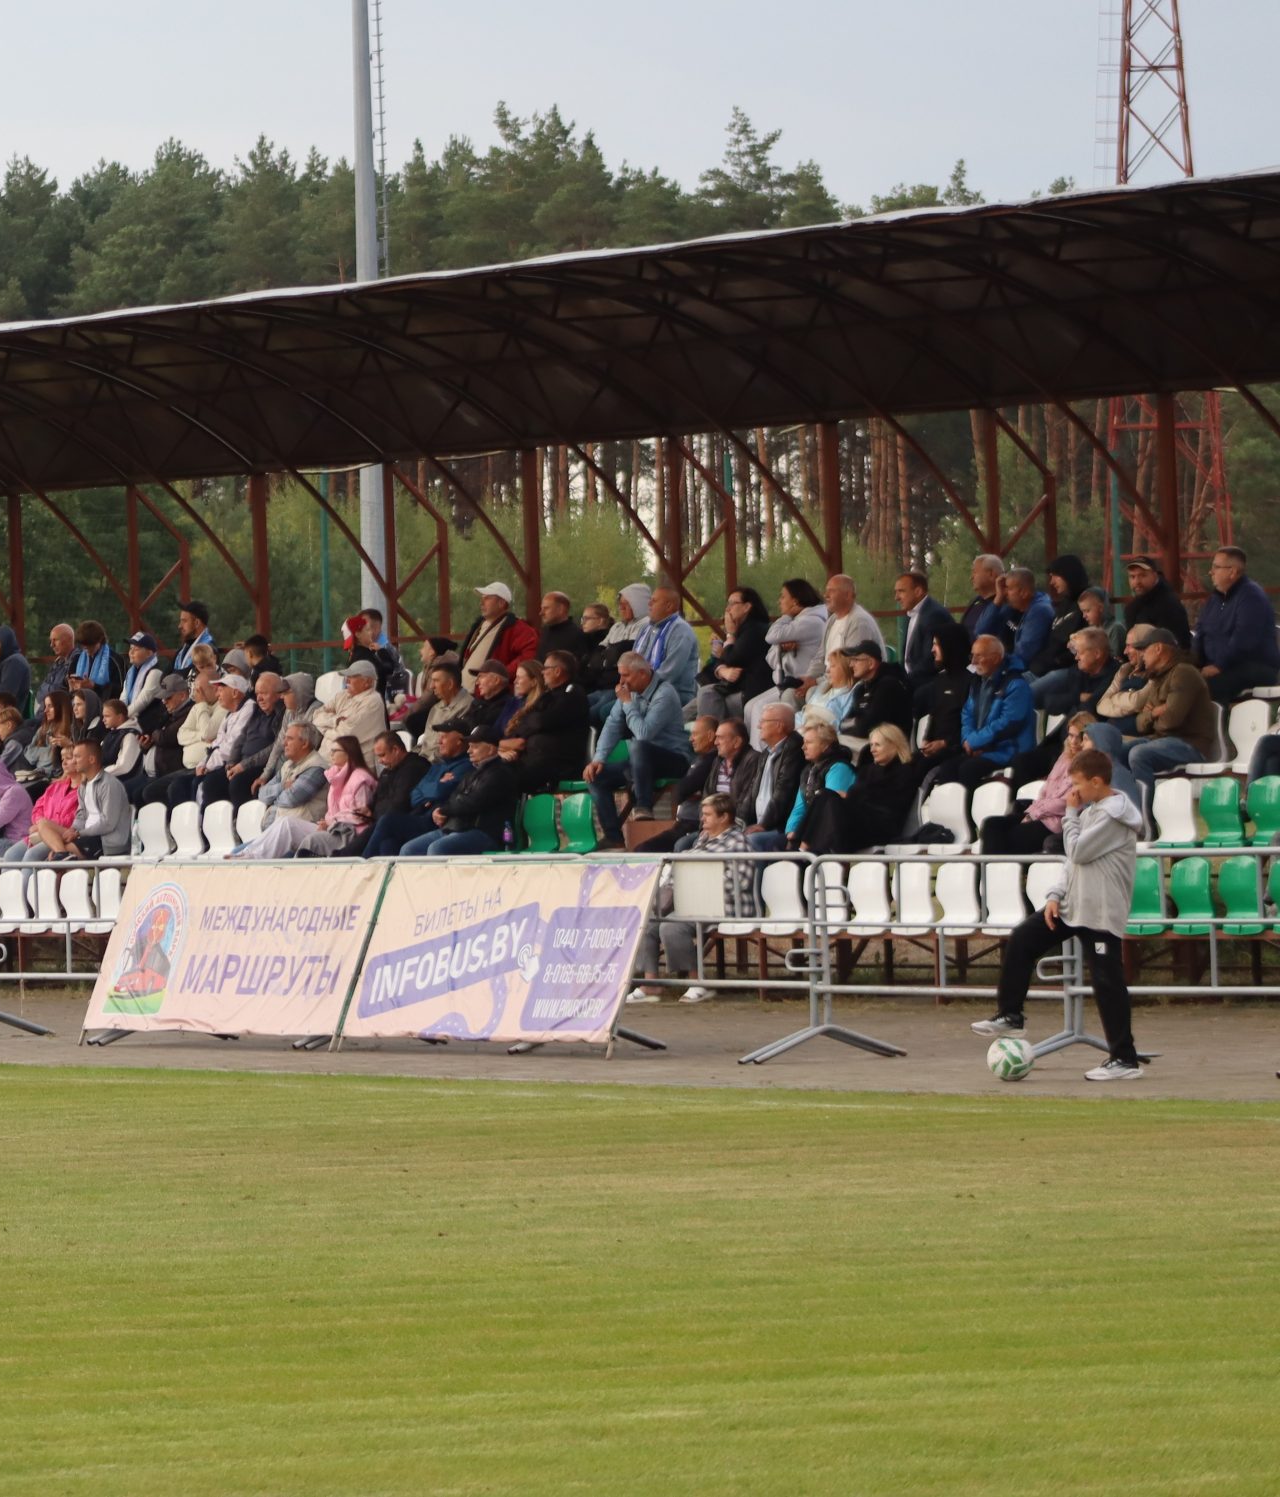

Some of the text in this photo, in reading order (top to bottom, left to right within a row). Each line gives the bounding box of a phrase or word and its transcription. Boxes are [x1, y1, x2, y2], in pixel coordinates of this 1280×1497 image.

[199, 905, 361, 936] МЕЖДУНАРОДНЫЕ
[414, 886, 502, 937] БИЛЕТЫ НА
[179, 954, 343, 995] МАРШРУТЫ
[369, 917, 528, 1004] INFOBUS.BY
